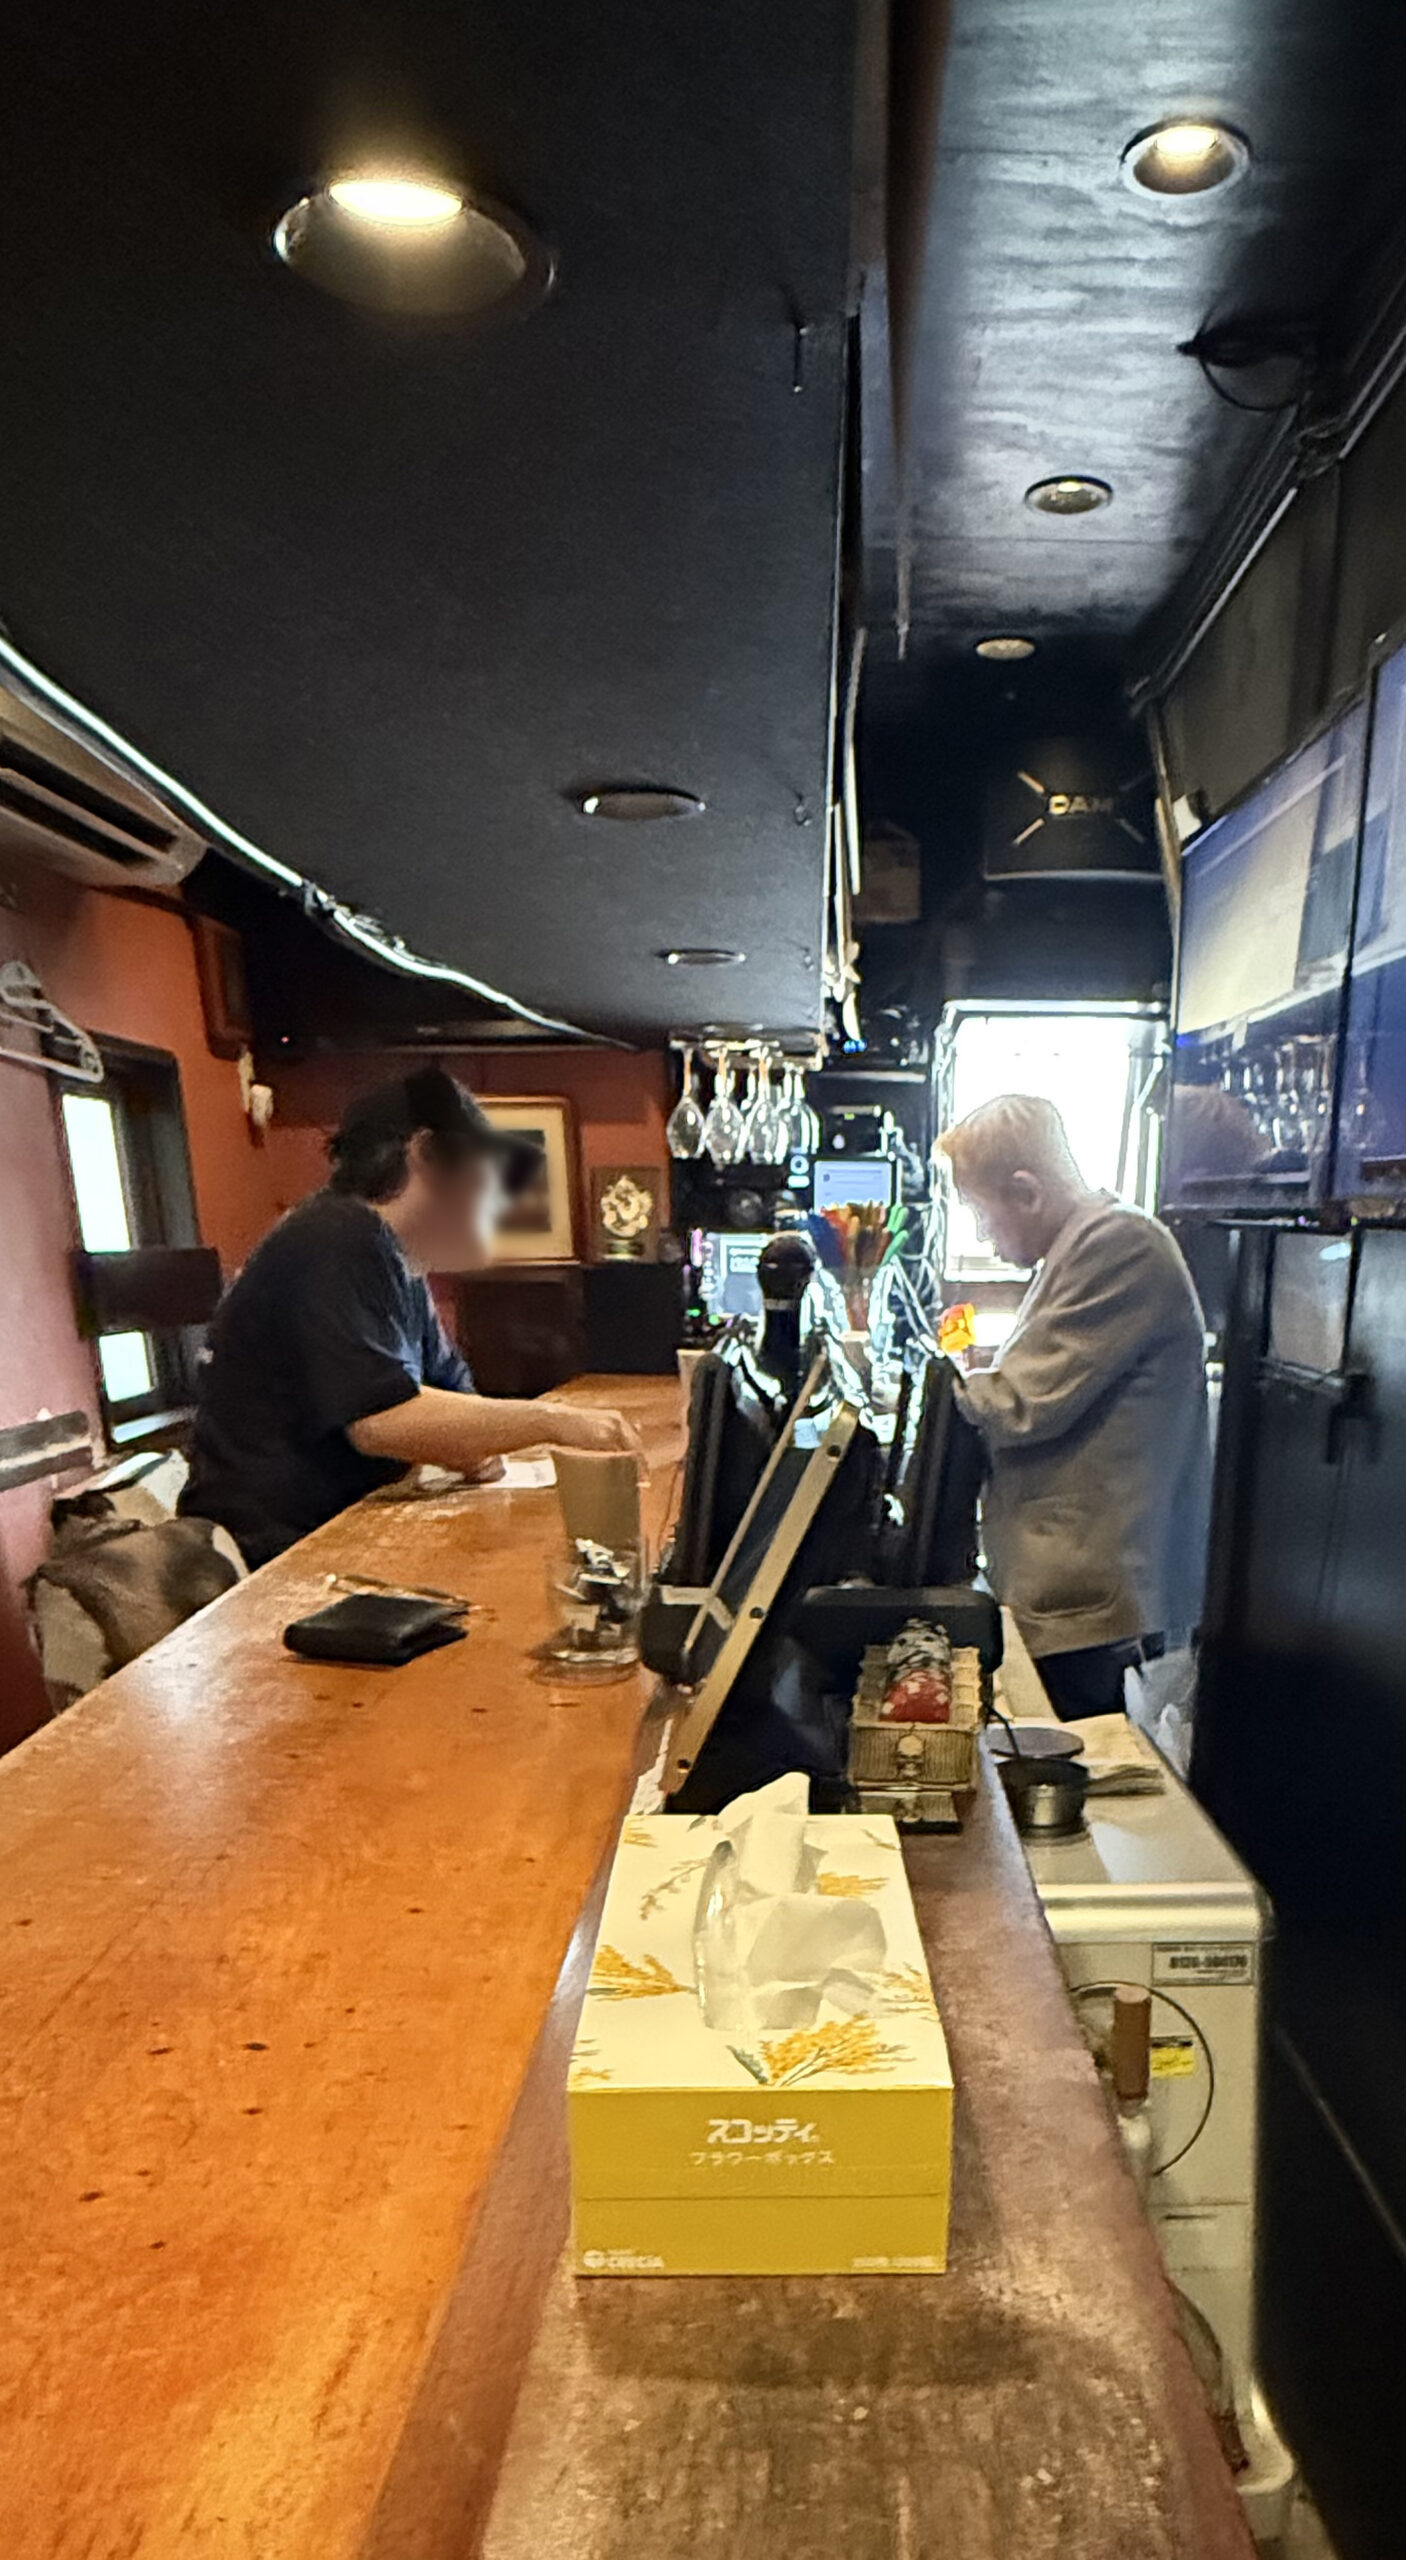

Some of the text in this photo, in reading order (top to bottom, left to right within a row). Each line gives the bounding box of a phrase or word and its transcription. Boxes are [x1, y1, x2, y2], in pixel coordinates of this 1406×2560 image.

[706, 2117, 818, 2144] スコッティ
